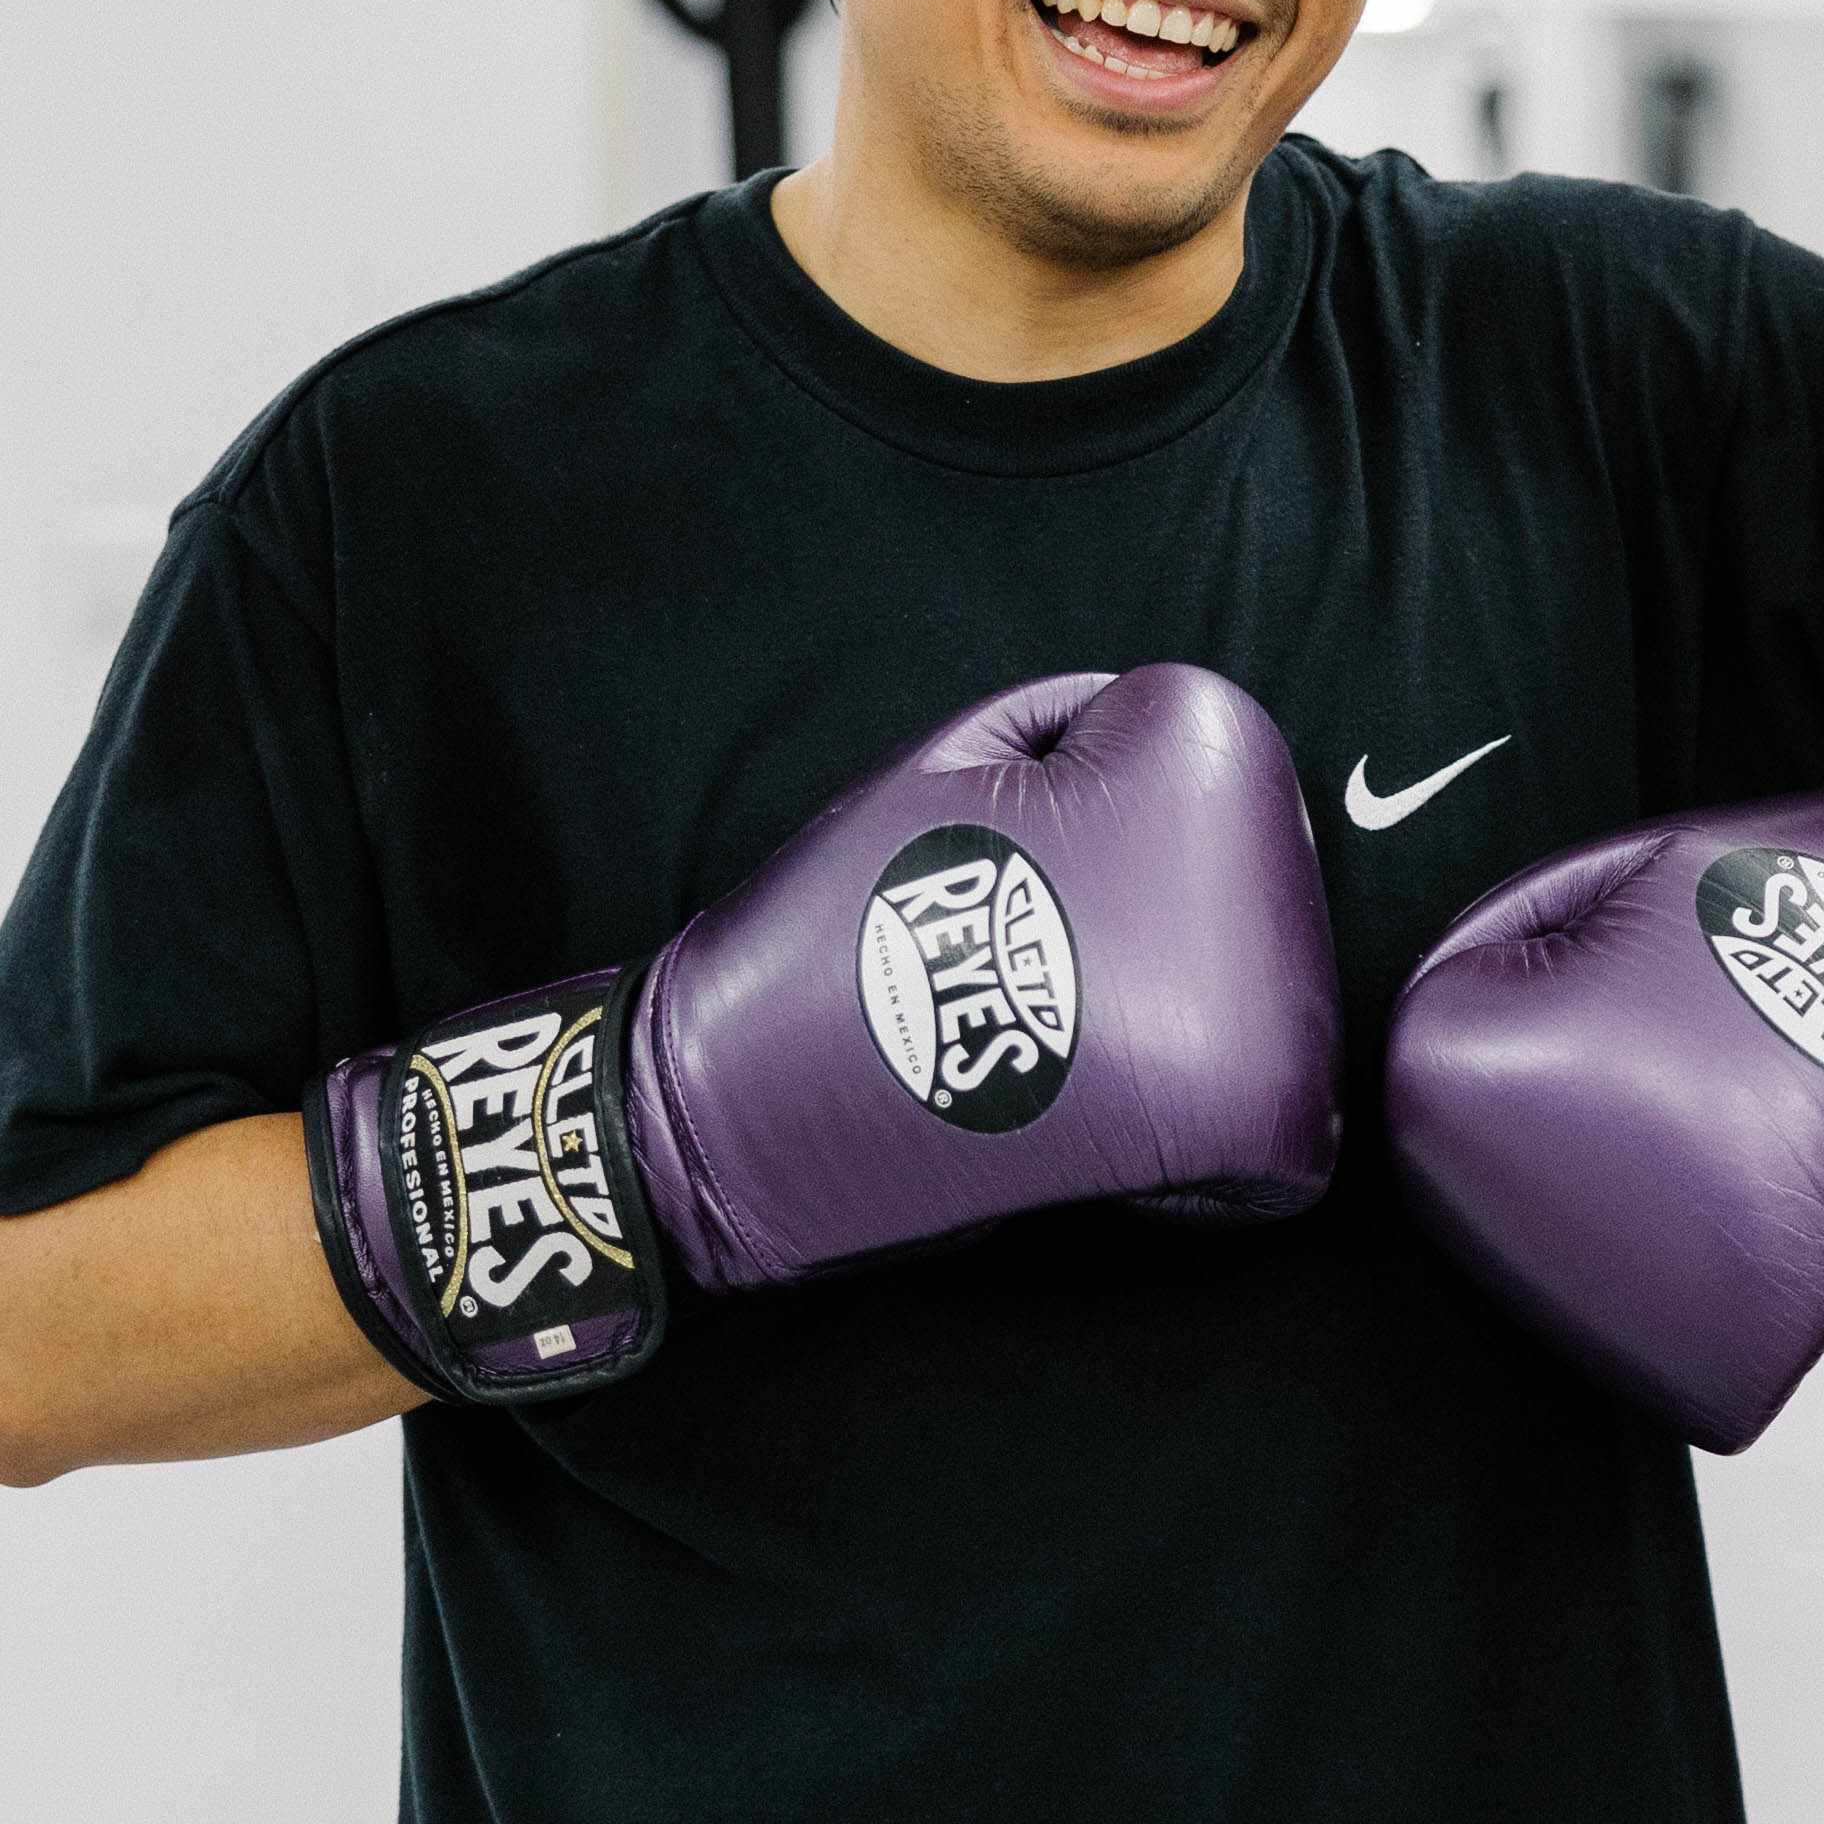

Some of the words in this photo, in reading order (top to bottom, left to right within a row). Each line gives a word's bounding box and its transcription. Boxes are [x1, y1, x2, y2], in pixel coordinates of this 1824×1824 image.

[874, 924, 894, 977] HECHO
[887, 984, 900, 1006] EN
[894, 1012, 922, 1076] MEXICO
[881, 858, 1040, 1092] REYES
[1004, 877, 1066, 1033] CLETO
[400, 1076, 444, 1283] PROFESIONAL
[421, 1012, 593, 1307] REYES
[422, 1088, 442, 1147] HECHO
[435, 1150, 449, 1176] EN
[546, 1035, 624, 1239] CLETO
[440, 1180, 455, 1258] MEXICO
